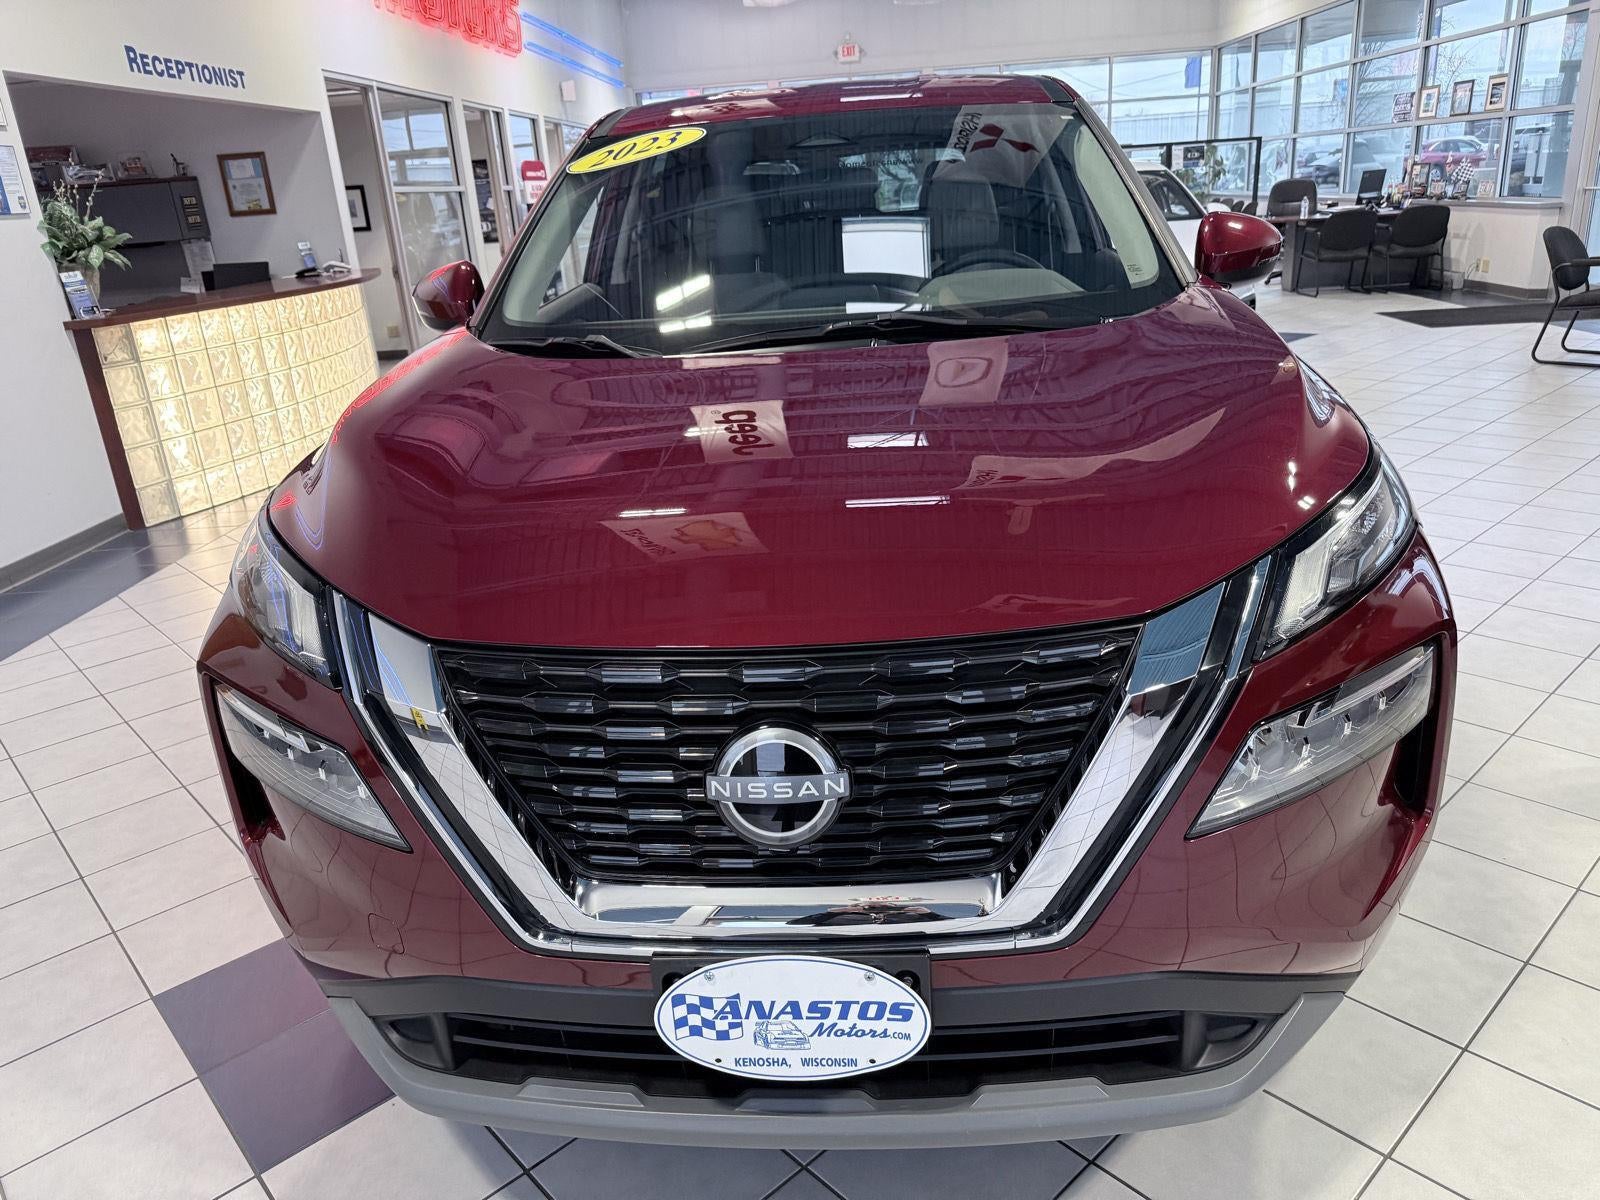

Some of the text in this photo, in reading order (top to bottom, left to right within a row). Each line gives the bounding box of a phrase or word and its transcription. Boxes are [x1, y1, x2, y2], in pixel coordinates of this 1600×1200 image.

[841, 44, 856, 57] EXIT
[124, 45, 246, 89] RECEPTIONIST
[588, 132, 682, 168] 2023
[711, 777, 845, 799] NISSAN
[713, 1000, 915, 1022] ANASTOS
[734, 1057, 858, 1069] KENOSHA, WISCONSIN
